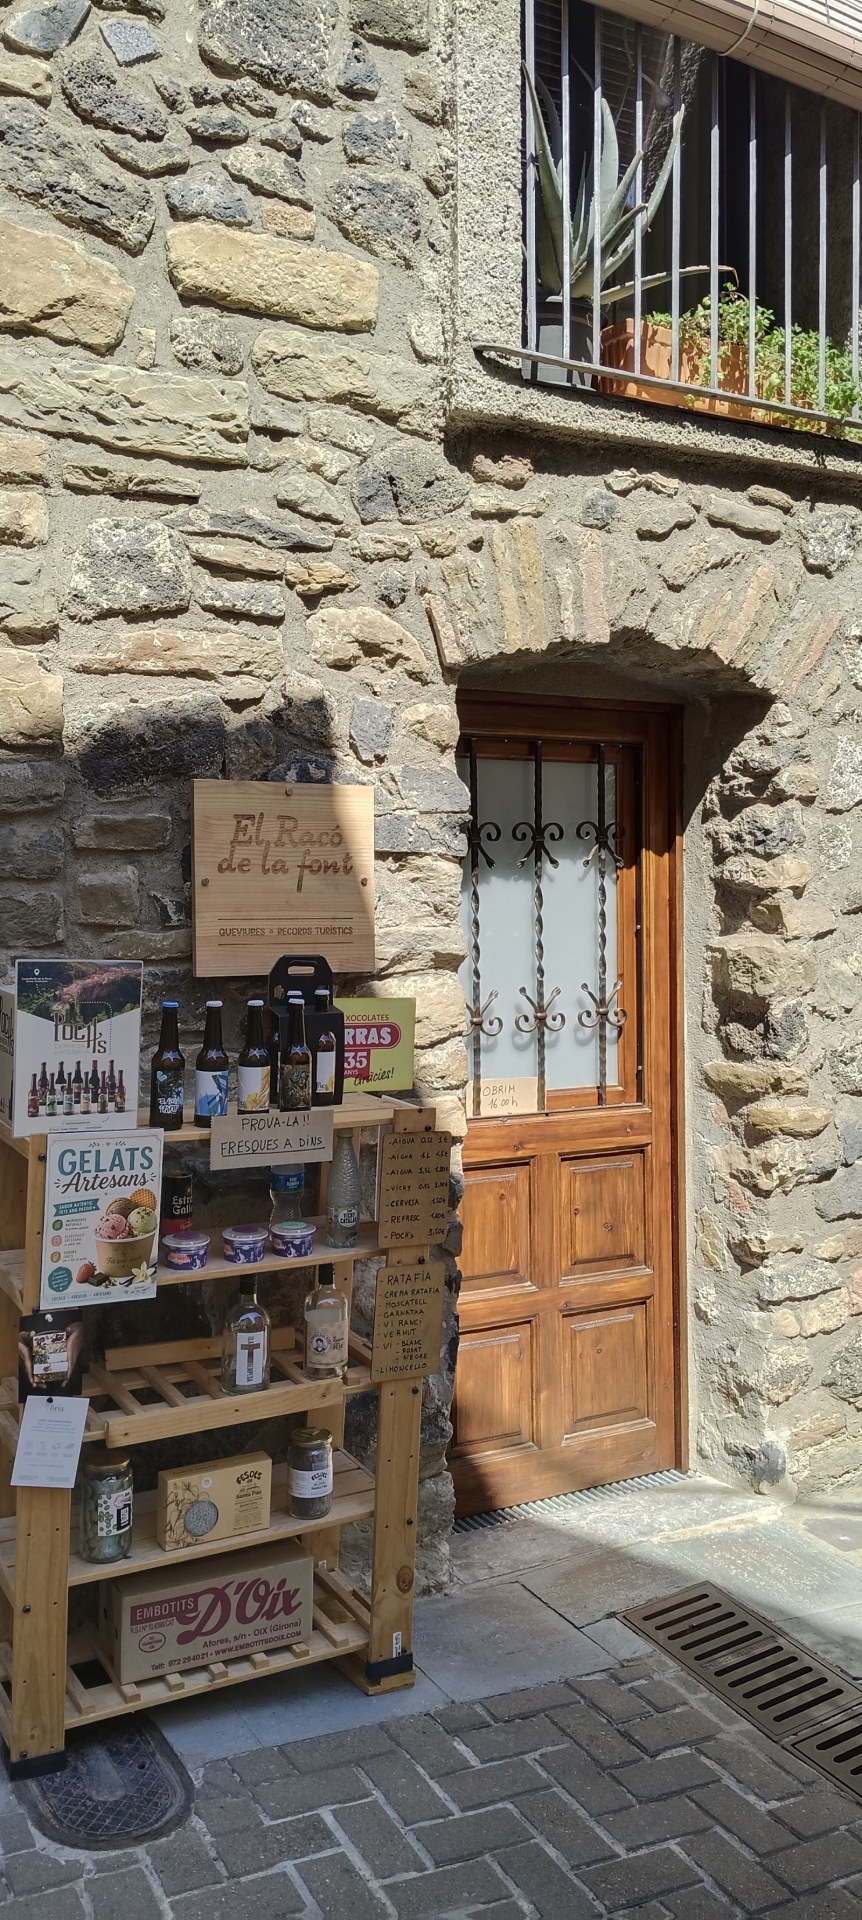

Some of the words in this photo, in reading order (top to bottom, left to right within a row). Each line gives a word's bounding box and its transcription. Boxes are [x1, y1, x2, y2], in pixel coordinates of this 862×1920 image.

[230, 811, 264, 847] El
[274, 815, 343, 848] Racó
[217, 841, 252, 875] de
[261, 840, 289, 875] la
[296, 849, 354, 893] font
[219, 927, 266, 937] QUEVIURES
[277, 926, 312, 936] RECORDS
[315, 924, 353, 936] TURÍSTICS
[345, 1014, 389, 1022] XOCOLATES
[344, 1027, 392, 1045] RRAS
[220, 1139, 279, 1154] FRESQUES
[283, 1139, 292, 1149] A
[58, 1146, 153, 1176] GELATS
[61, 1171, 149, 1194] Artesans
[390, 1198, 420, 1207] CERVESA
[385, 1299, 427, 1309] MOSCATELL
[383, 1309, 424, 1319] GARNATXA
[380, 1363, 427, 1374] LIMONCELLO
[136, 1598, 194, 1620] EMBOTITS
[175, 1577, 303, 1646] D'Oix
[202, 1638, 232, 1649] Afores,
[233, 1633, 246, 1642] s/n
[253, 1627, 268, 1637] OIX
[269, 1619, 302, 1634] (Girona)
